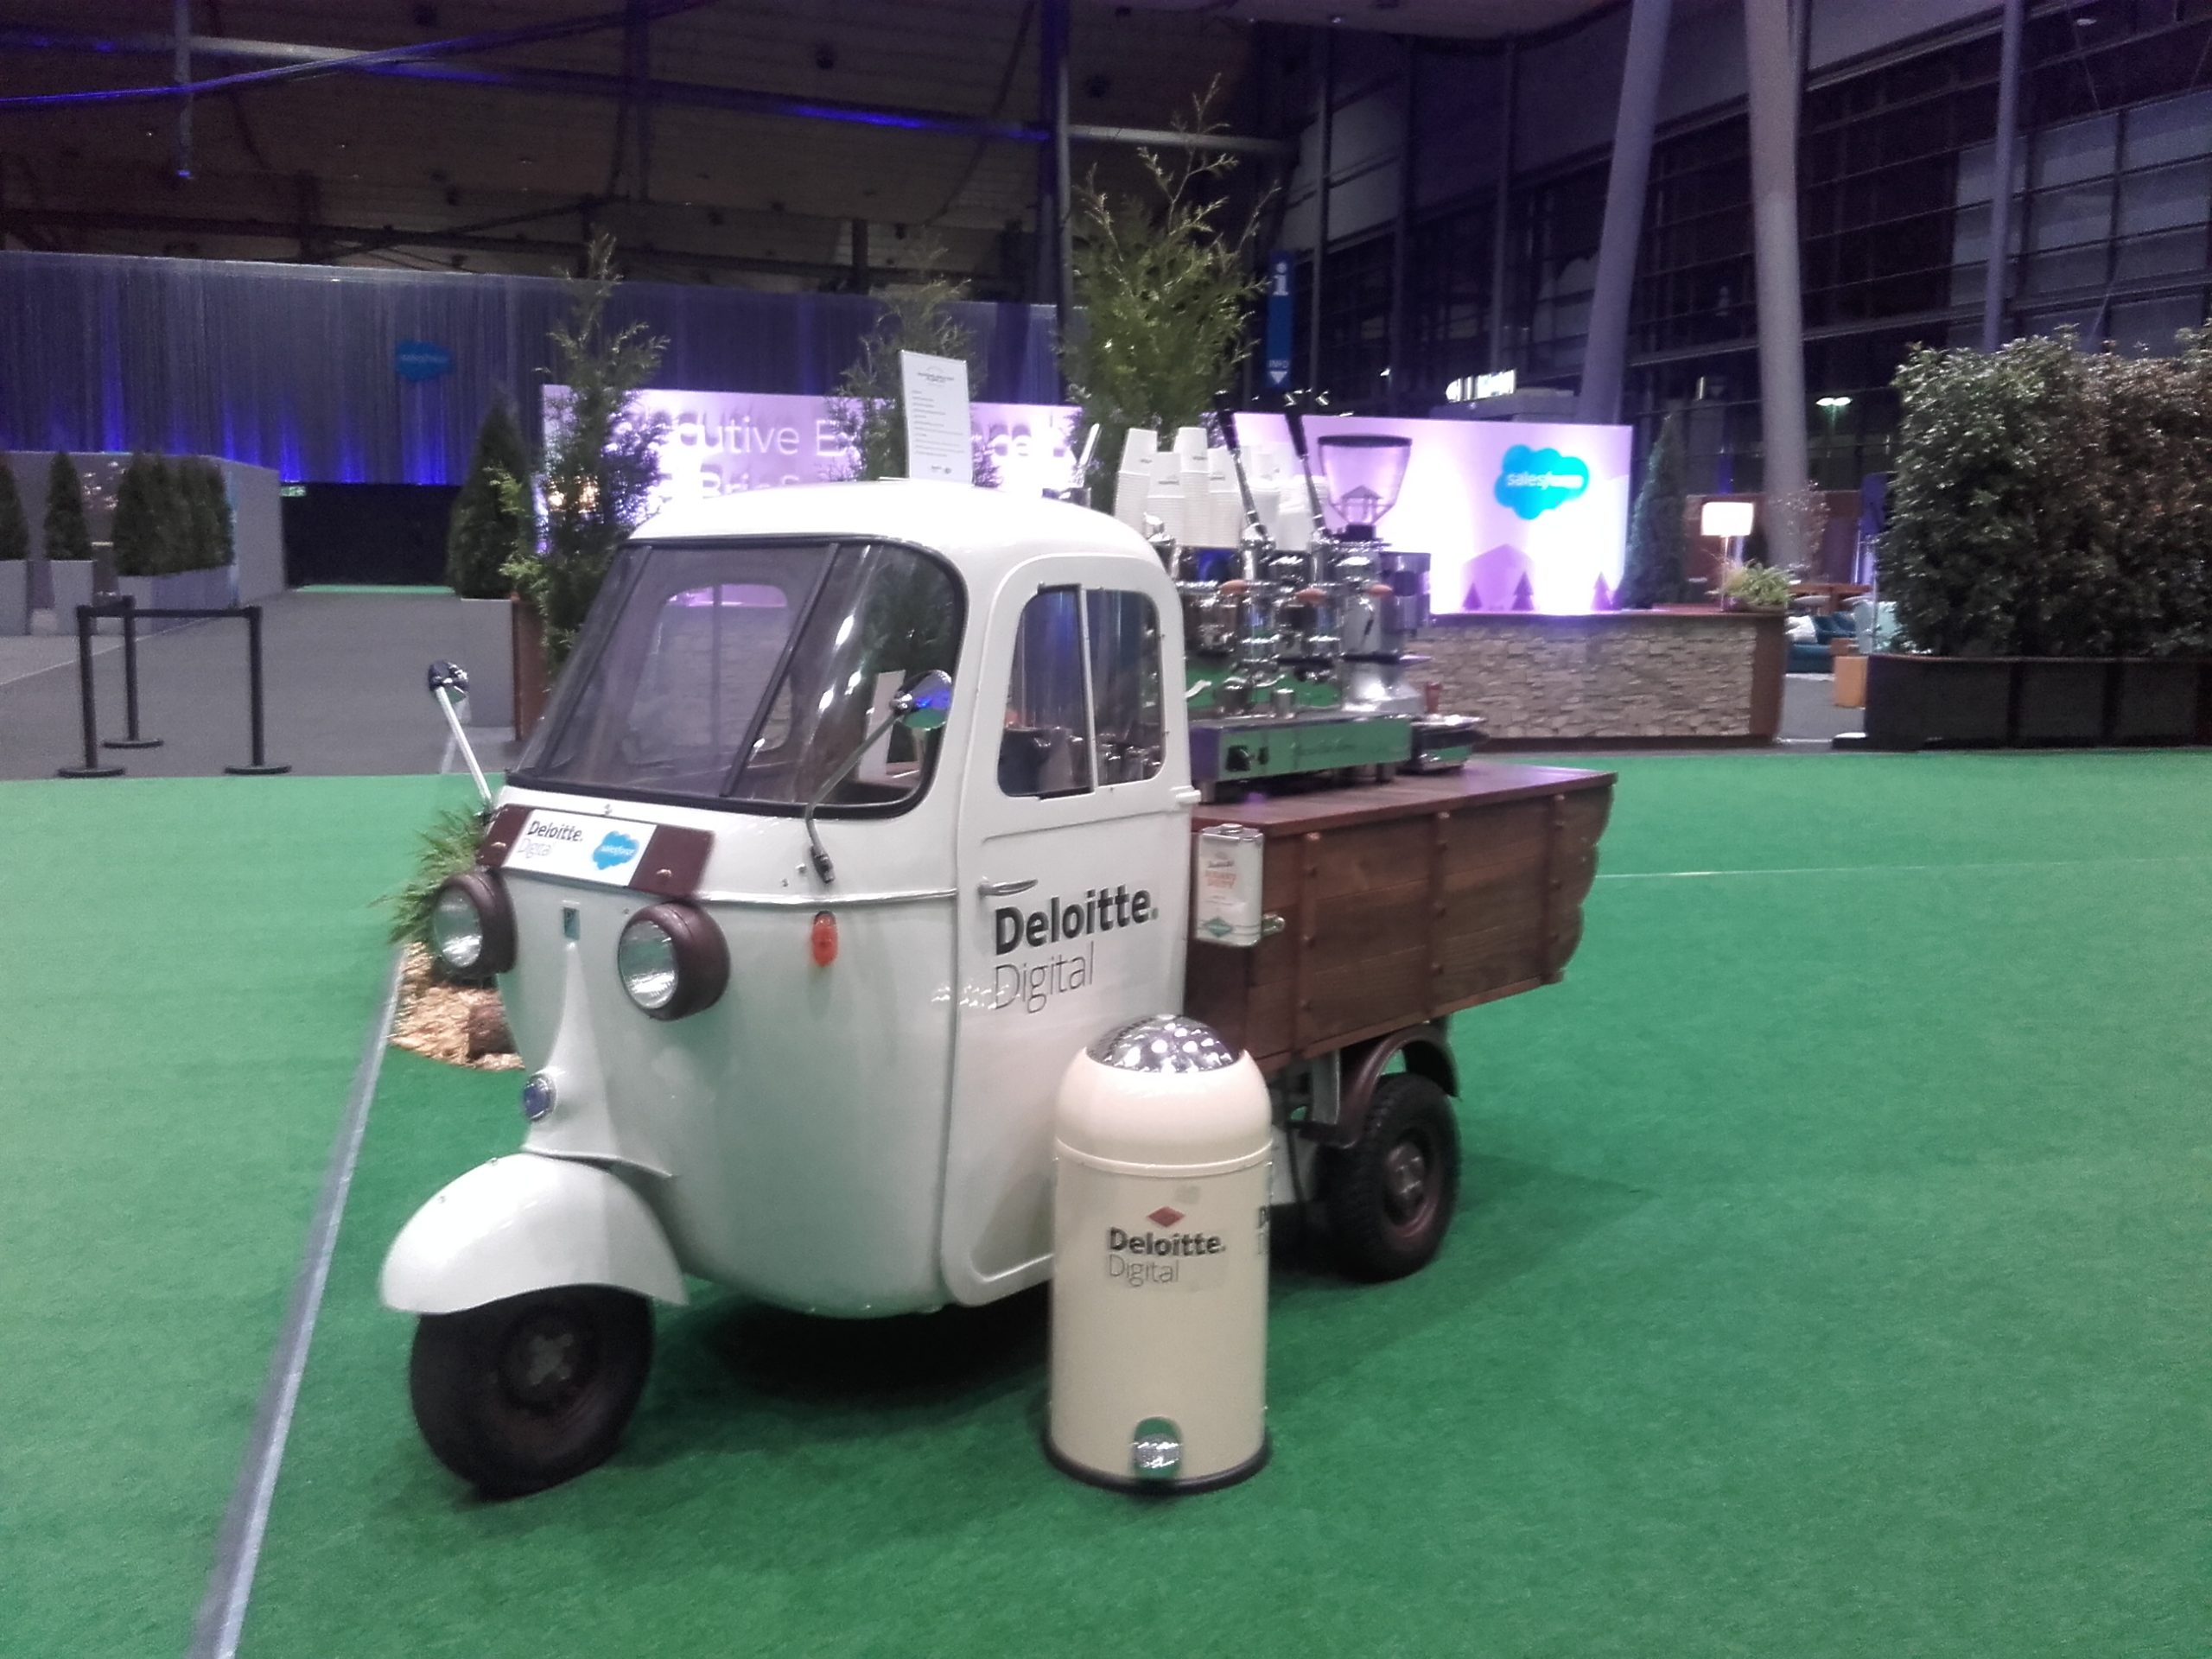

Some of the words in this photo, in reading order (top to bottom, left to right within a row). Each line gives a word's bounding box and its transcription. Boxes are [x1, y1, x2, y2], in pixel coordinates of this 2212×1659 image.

[1507, 471, 1584, 490] salesf
[995, 884, 1159, 955] Deloitte.
[995, 941, 1094, 1013] Digital
[1108, 1227, 1226, 1255] Deloitte.
[1109, 1254, 1179, 1287] Digital
